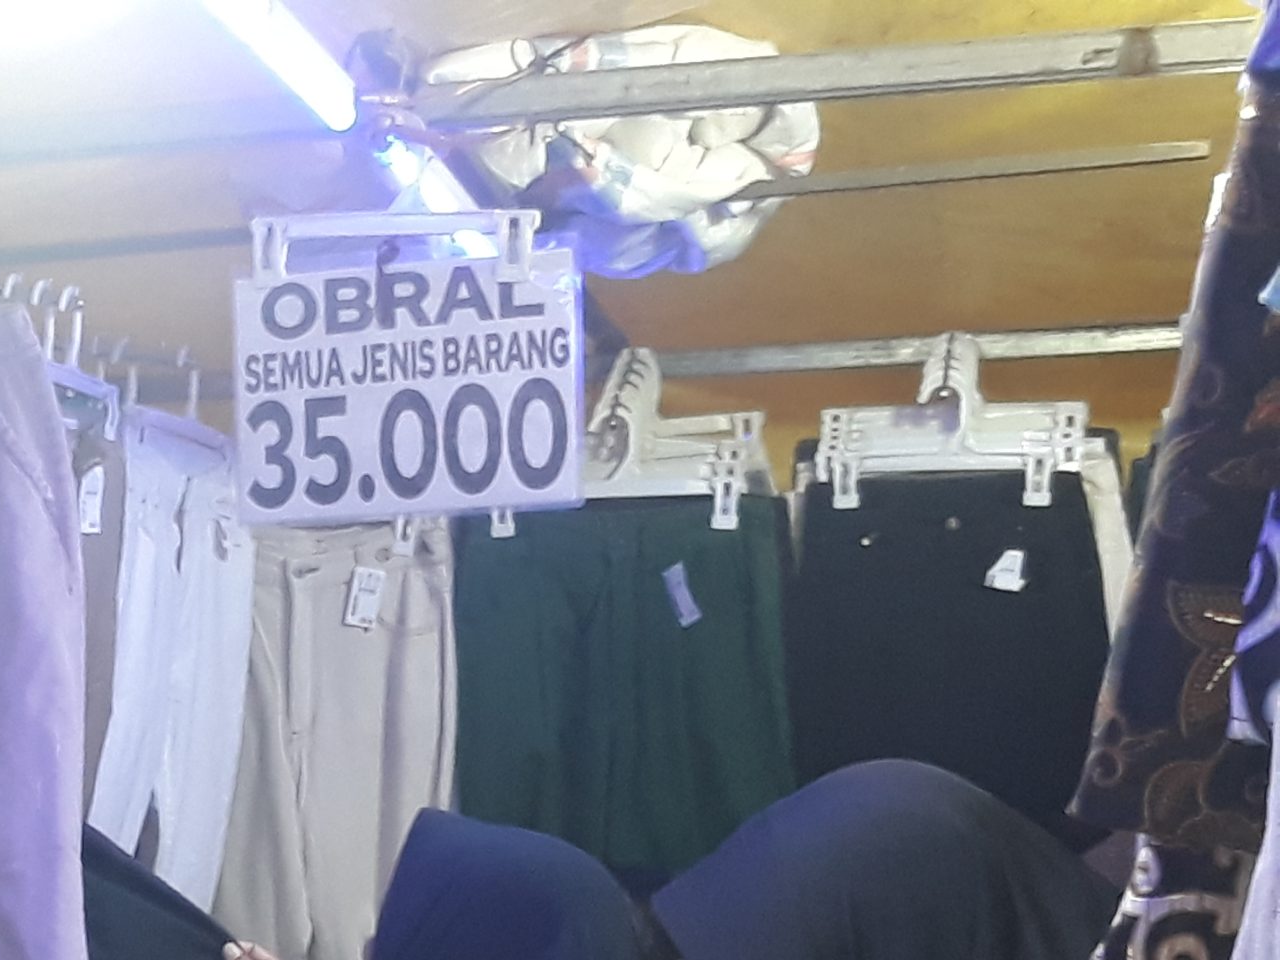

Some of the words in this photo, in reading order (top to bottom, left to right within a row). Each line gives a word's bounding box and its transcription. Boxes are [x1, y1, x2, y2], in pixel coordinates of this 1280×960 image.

[261, 265, 545, 340] OBRAL
[245, 346, 346, 394] SEMUA
[350, 338, 435, 384] JENIS
[442, 327, 572, 377] BARANG
[245, 377, 568, 509] 35.000
